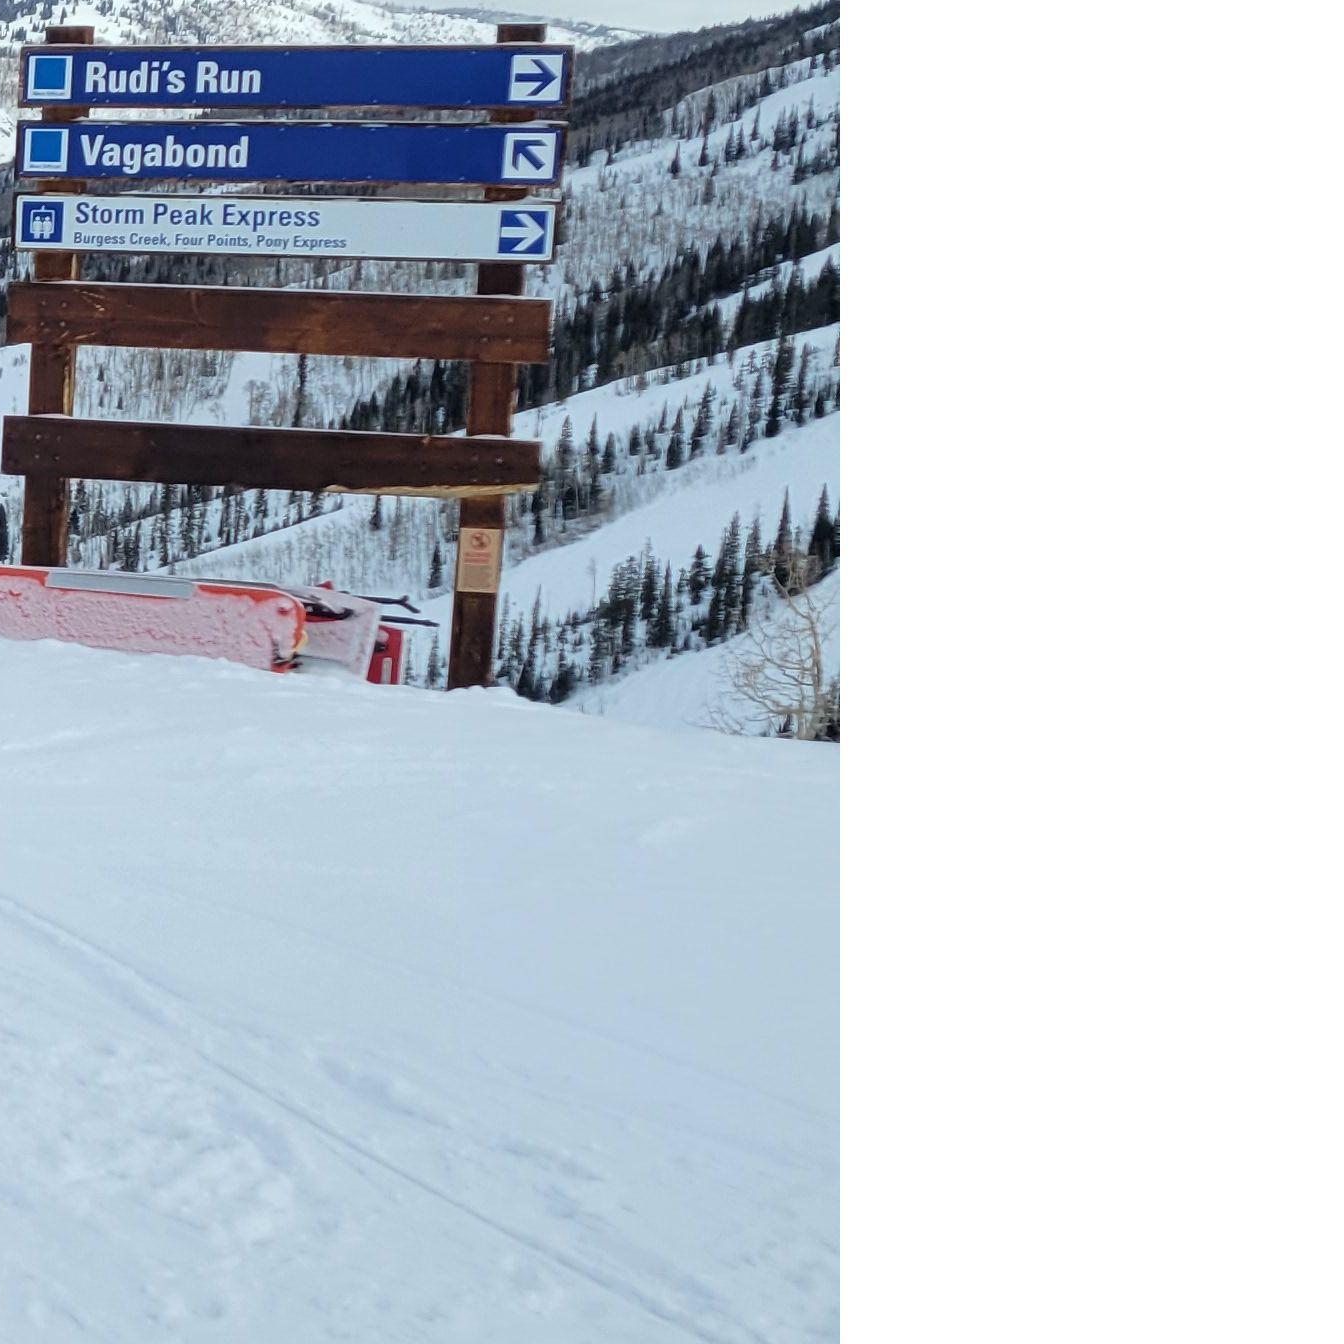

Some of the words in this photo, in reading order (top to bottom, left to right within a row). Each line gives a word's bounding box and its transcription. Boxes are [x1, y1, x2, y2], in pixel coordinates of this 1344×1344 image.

[84, 60, 186, 94] Rudi's
[195, 60, 262, 94] Run
[80, 134, 250, 174] Vagabond
[75, 201, 145, 225] Storm
[153, 203, 214, 226] Peak
[222, 203, 321, 233] Express
[73, 232, 126, 247] Burgess
[129, 232, 171, 246] Creek,
[174, 233, 204, 246] Four
[207, 234, 252, 248] Points,
[256, 235, 290, 250] Pony
[293, 235, 347, 250] Express
